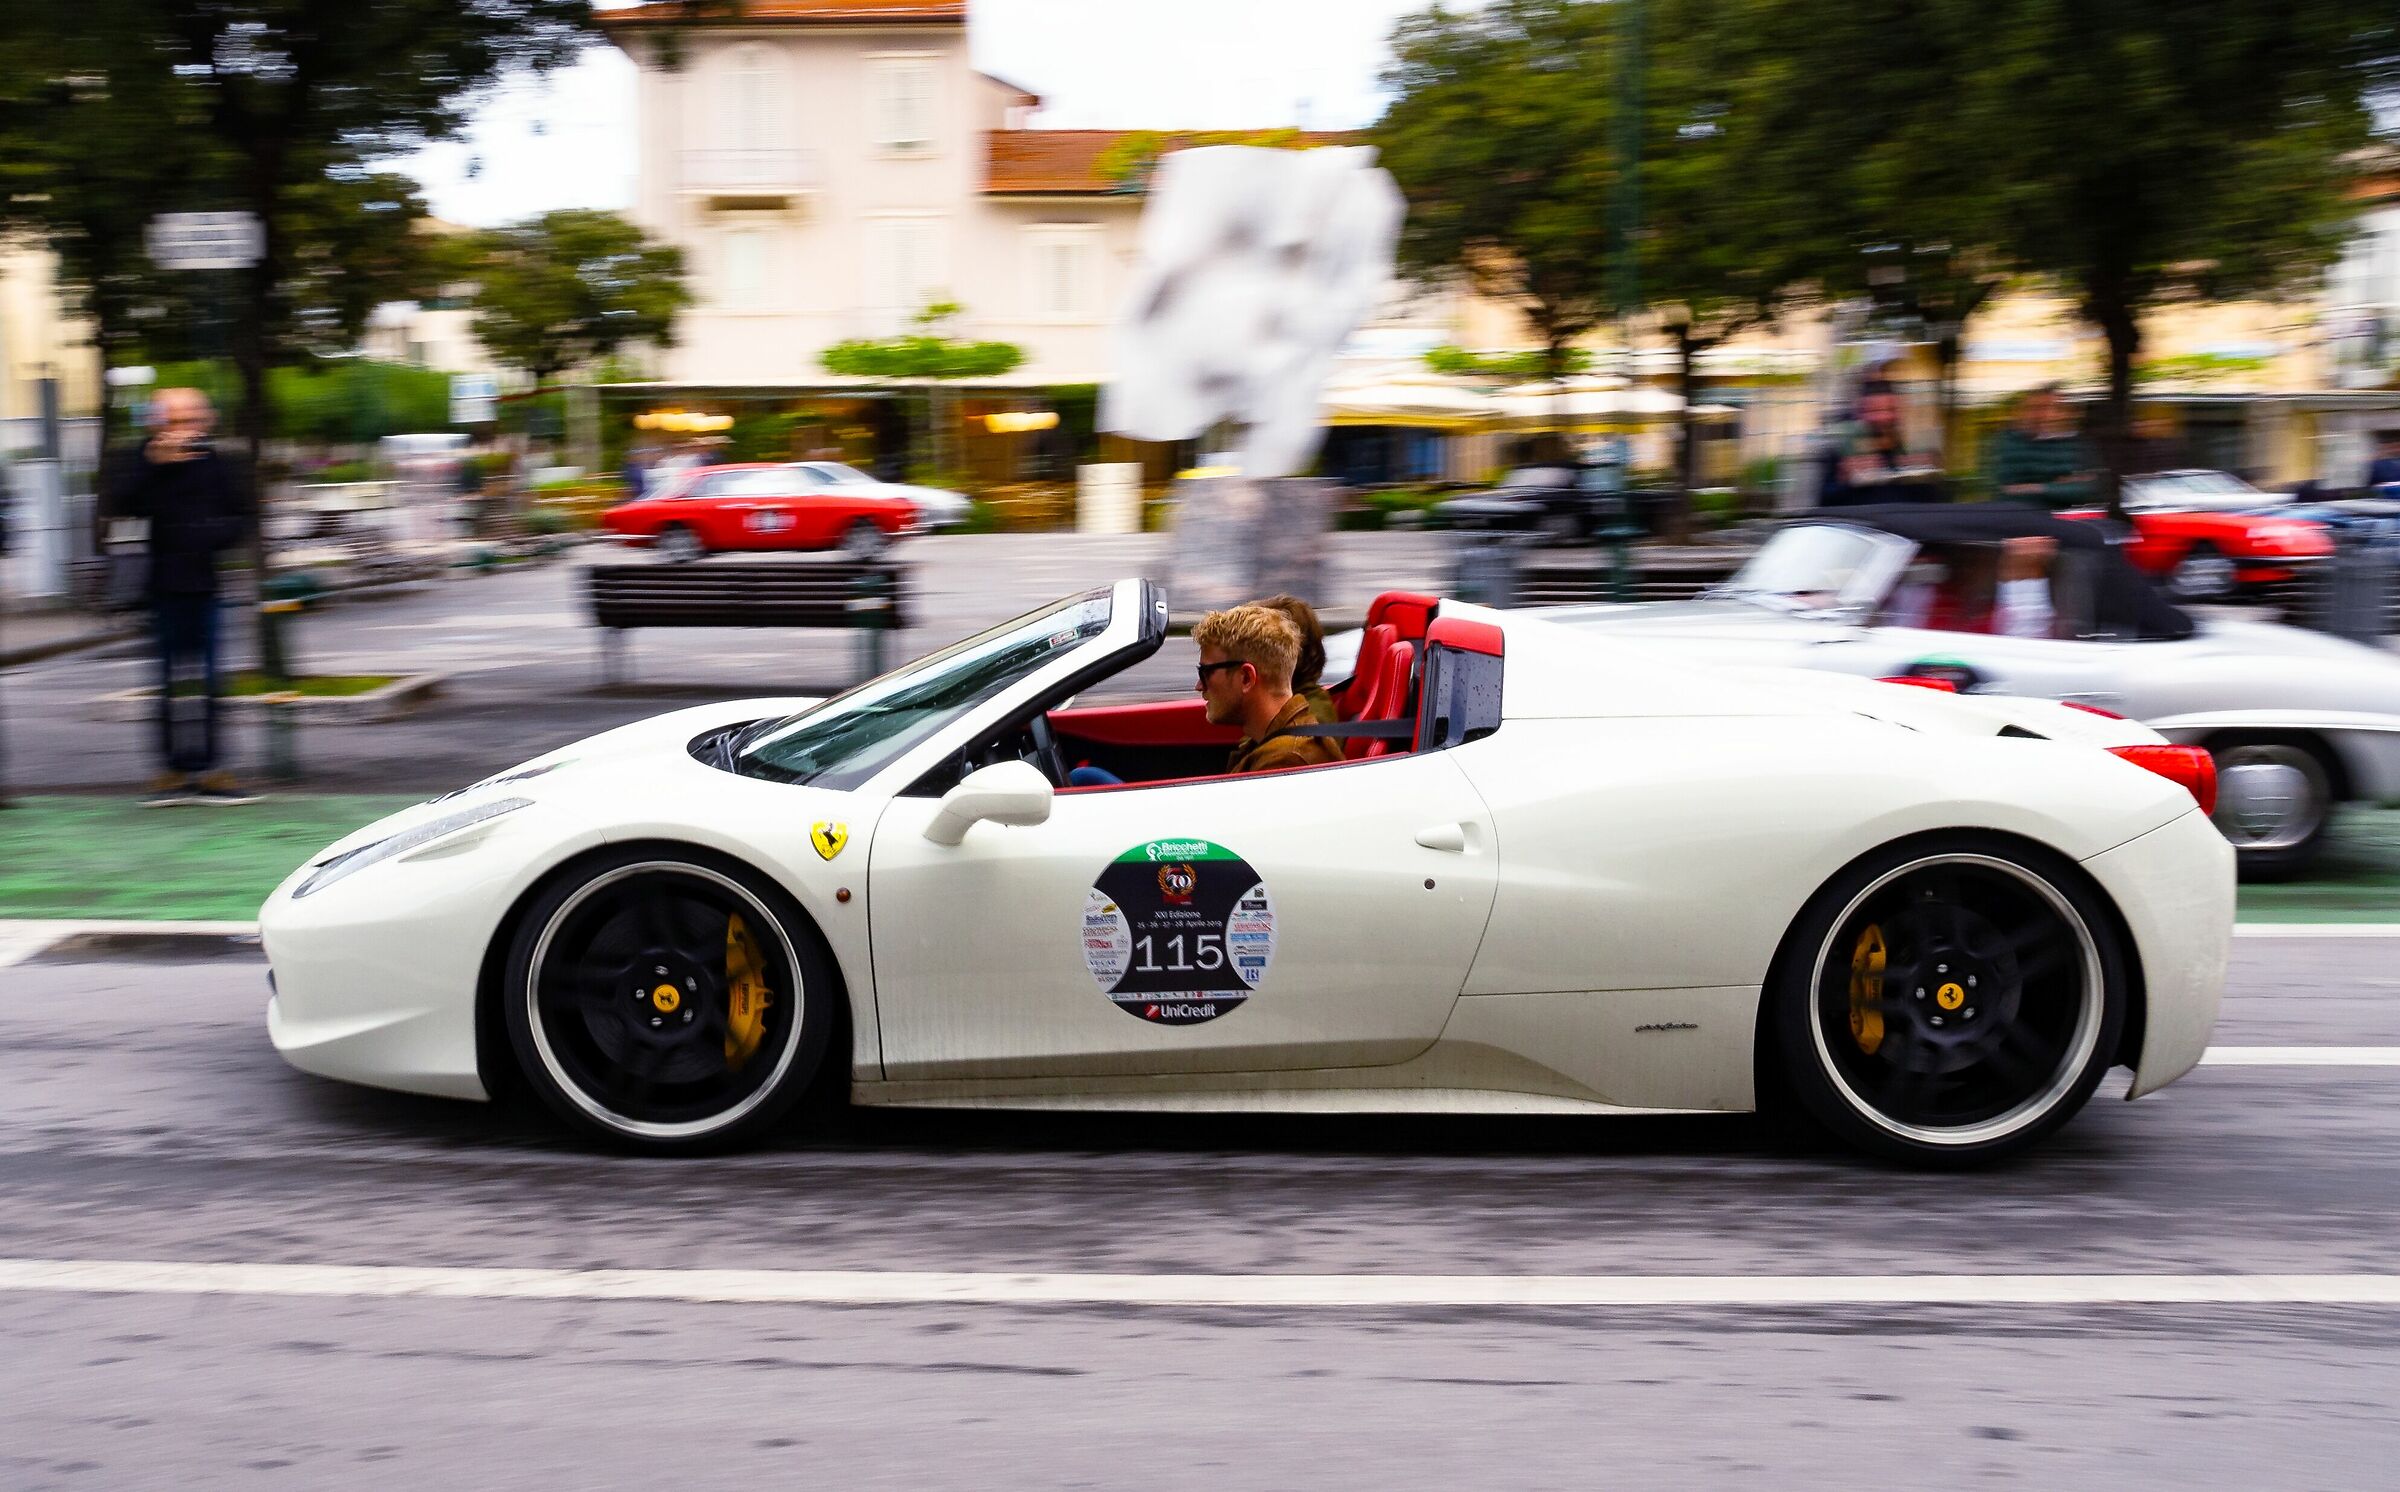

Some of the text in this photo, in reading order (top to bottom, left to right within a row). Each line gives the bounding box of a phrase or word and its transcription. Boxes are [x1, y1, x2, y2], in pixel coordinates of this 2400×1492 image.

[1161, 841, 1208, 852] Bricchetti
[1169, 910, 1201, 919] Edizione
[1136, 934, 1224, 972] 115
[1161, 1003, 1217, 1018] UniCredit
